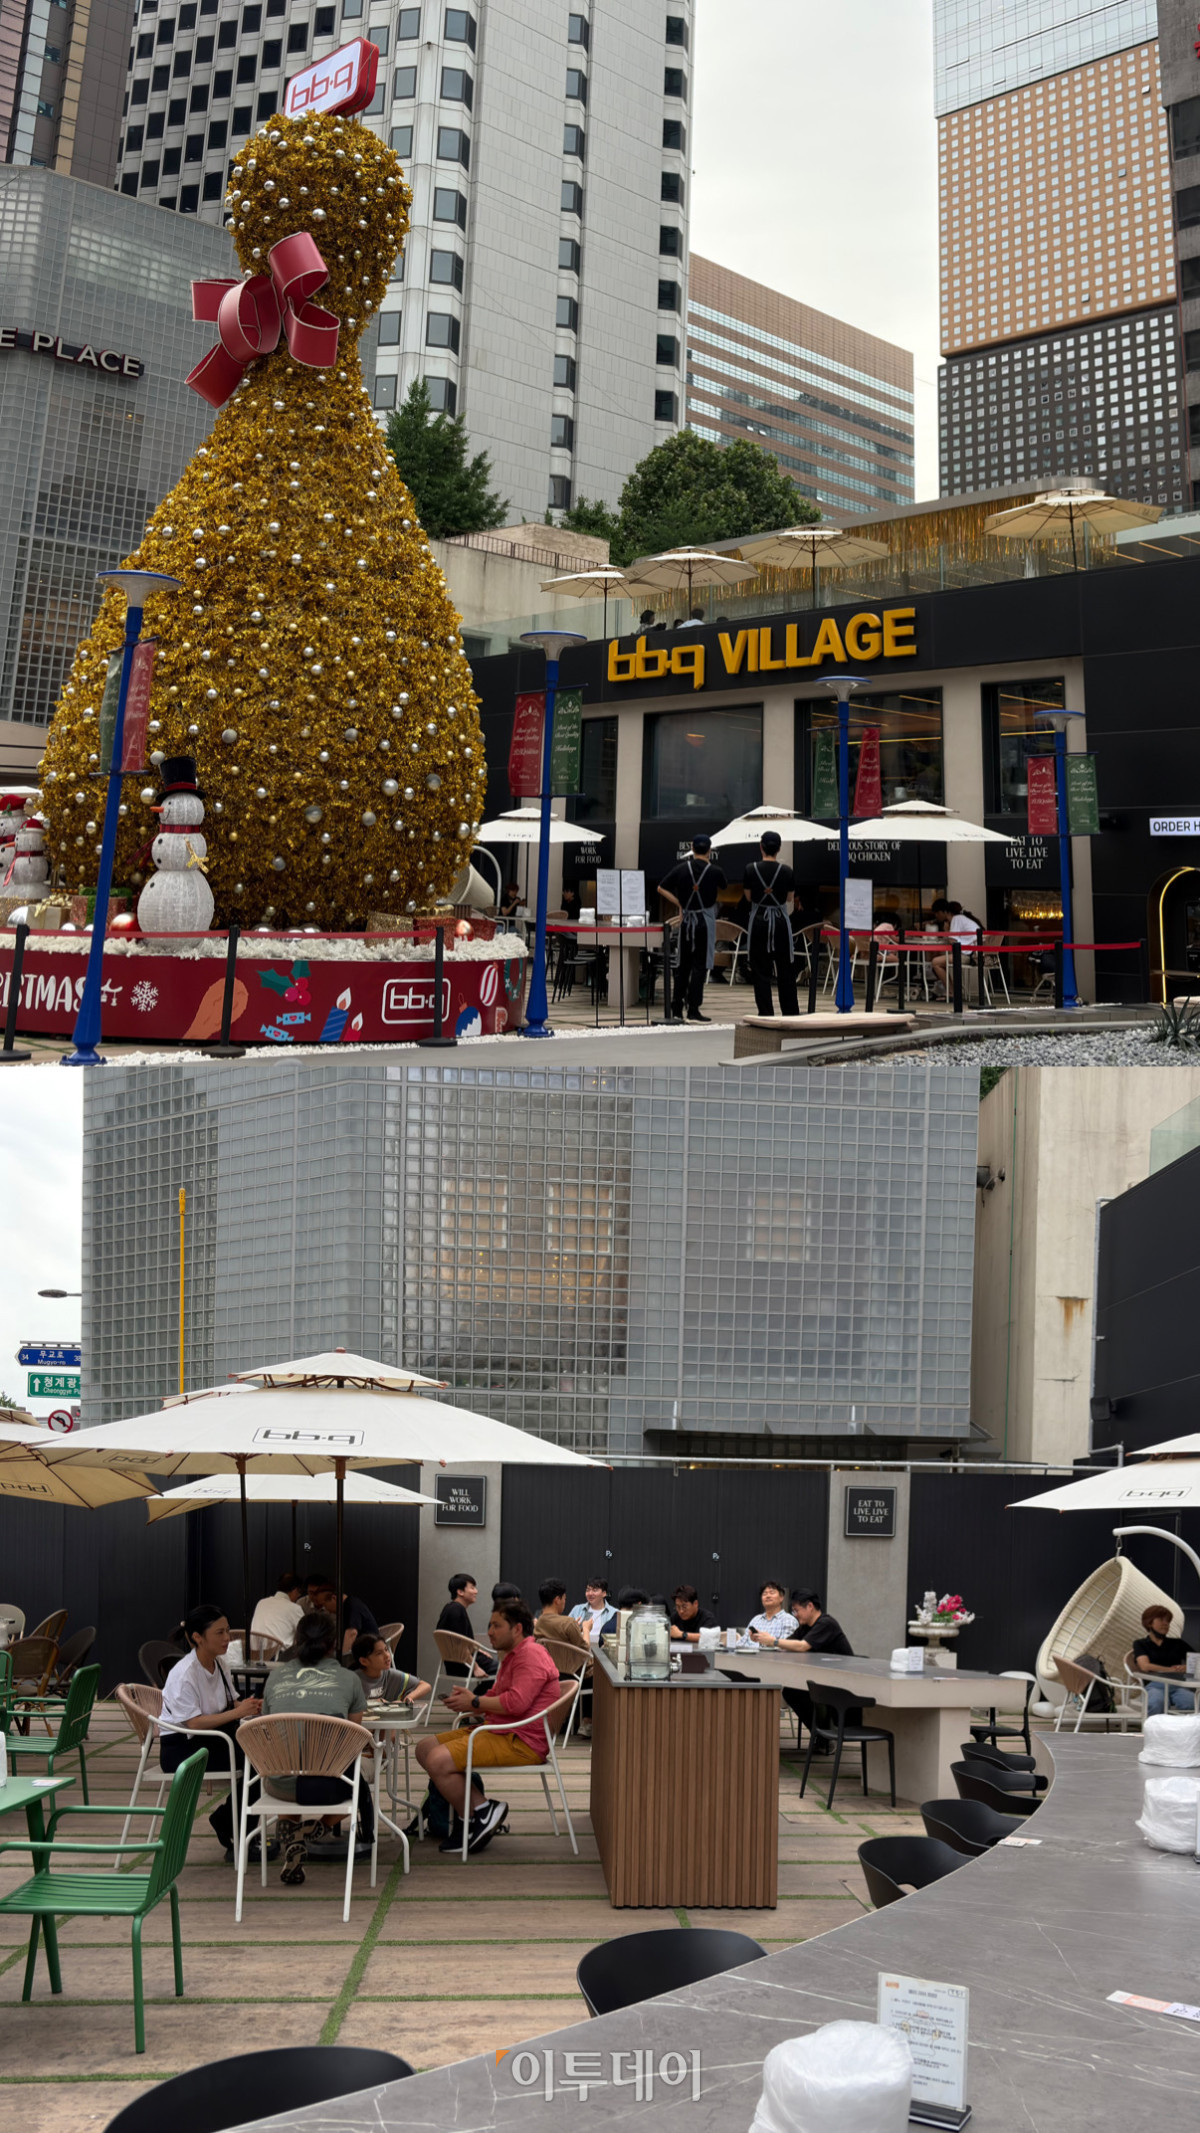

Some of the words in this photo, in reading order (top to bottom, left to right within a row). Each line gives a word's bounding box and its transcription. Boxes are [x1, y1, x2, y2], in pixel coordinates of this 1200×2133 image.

[33, 330, 140, 377] PLACE
[717, 607, 917, 675] VILLAGE
[1153, 821, 1191, 832] ORDER
[864, 841, 888, 850] STORY
[891, 841, 902, 850] OF
[580, 846, 597, 855] WORK
[1029, 847, 1049, 858] LIVE
[575, 855, 586, 864] FOR
[586, 855, 602, 864] FOOD
[858, 852, 891, 861] CHICKEN
[1010, 858, 1024, 869] TO
[1026, 858, 1044, 869] EAT
[21, 1353, 29, 1361] 34
[39, 1350, 64, 1359] 무교로
[44, 1376, 80, 1389] 청계광
[43, 1387, 72, 1396] Cheonggye
[452, 1488, 470, 1496] WILL
[449, 1496, 471, 1504] WORK
[858, 1500, 872, 1508] EAT
[874, 1500, 885, 1508] TO
[442, 1504, 457, 1512] FOR
[458, 1504, 479, 1512] FOOD
[872, 1508, 889, 1516] LIVE
[870, 1516, 885, 1524] EAT
